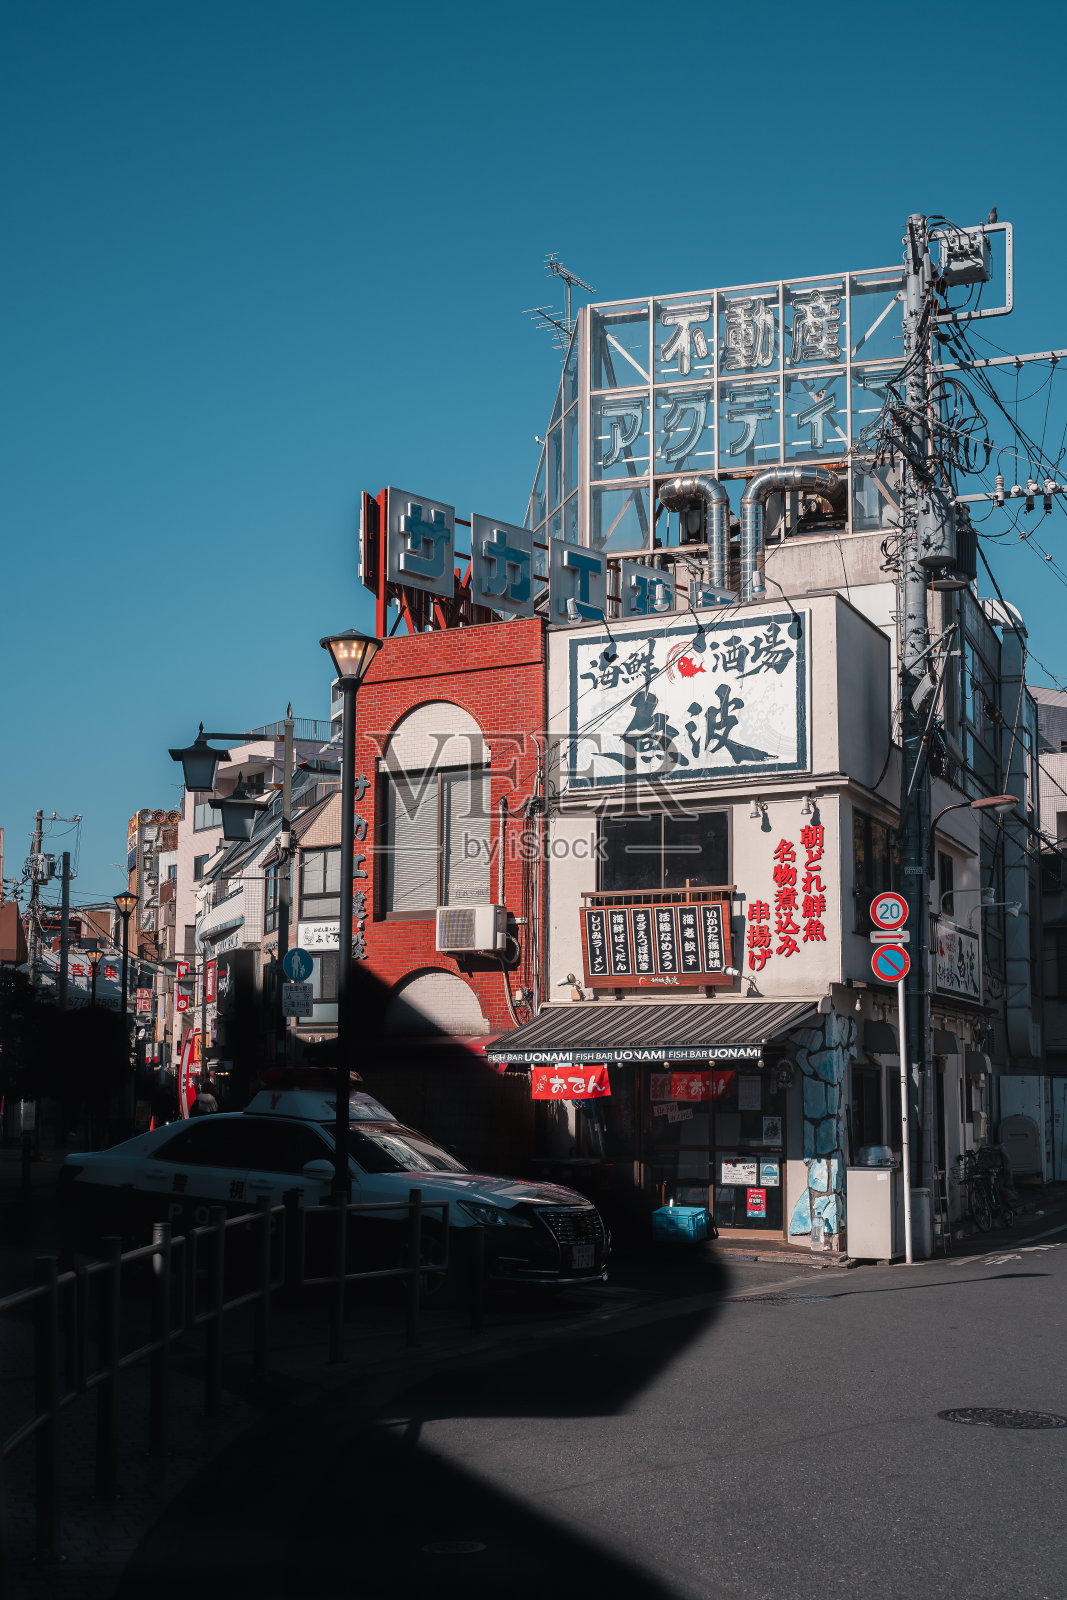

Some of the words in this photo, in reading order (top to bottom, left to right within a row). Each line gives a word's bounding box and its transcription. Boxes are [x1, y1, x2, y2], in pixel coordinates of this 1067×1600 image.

[660, 289, 841, 377] 不動産
[580, 638, 660, 698] 海鮮
[710, 622, 794, 679] 酒場
[592, 684, 778, 769] 魚波
[773, 839, 800, 957] 名物煮込み
[800, 824, 826, 942] 朝どれ鮮魚
[879, 902, 901, 920] 20
[591, 915, 604, 972] しじみラーメン
[682, 914, 697, 965] 海老餃子
[747, 900, 773, 972] 串揚げ
[55, 963, 118, 979] 告募集
[524, 1052, 572, 1062] UONAMI
[575, 1053, 594, 1061] FISH
[596, 1053, 613, 1061] BAR
[614, 1050, 665, 1060] UONAMI
[668, 1050, 688, 1059] FISH
[689, 1050, 708, 1058] BAR
[708, 1047, 761, 1058] UONAMI
[549, 1074, 606, 1094] おでん
